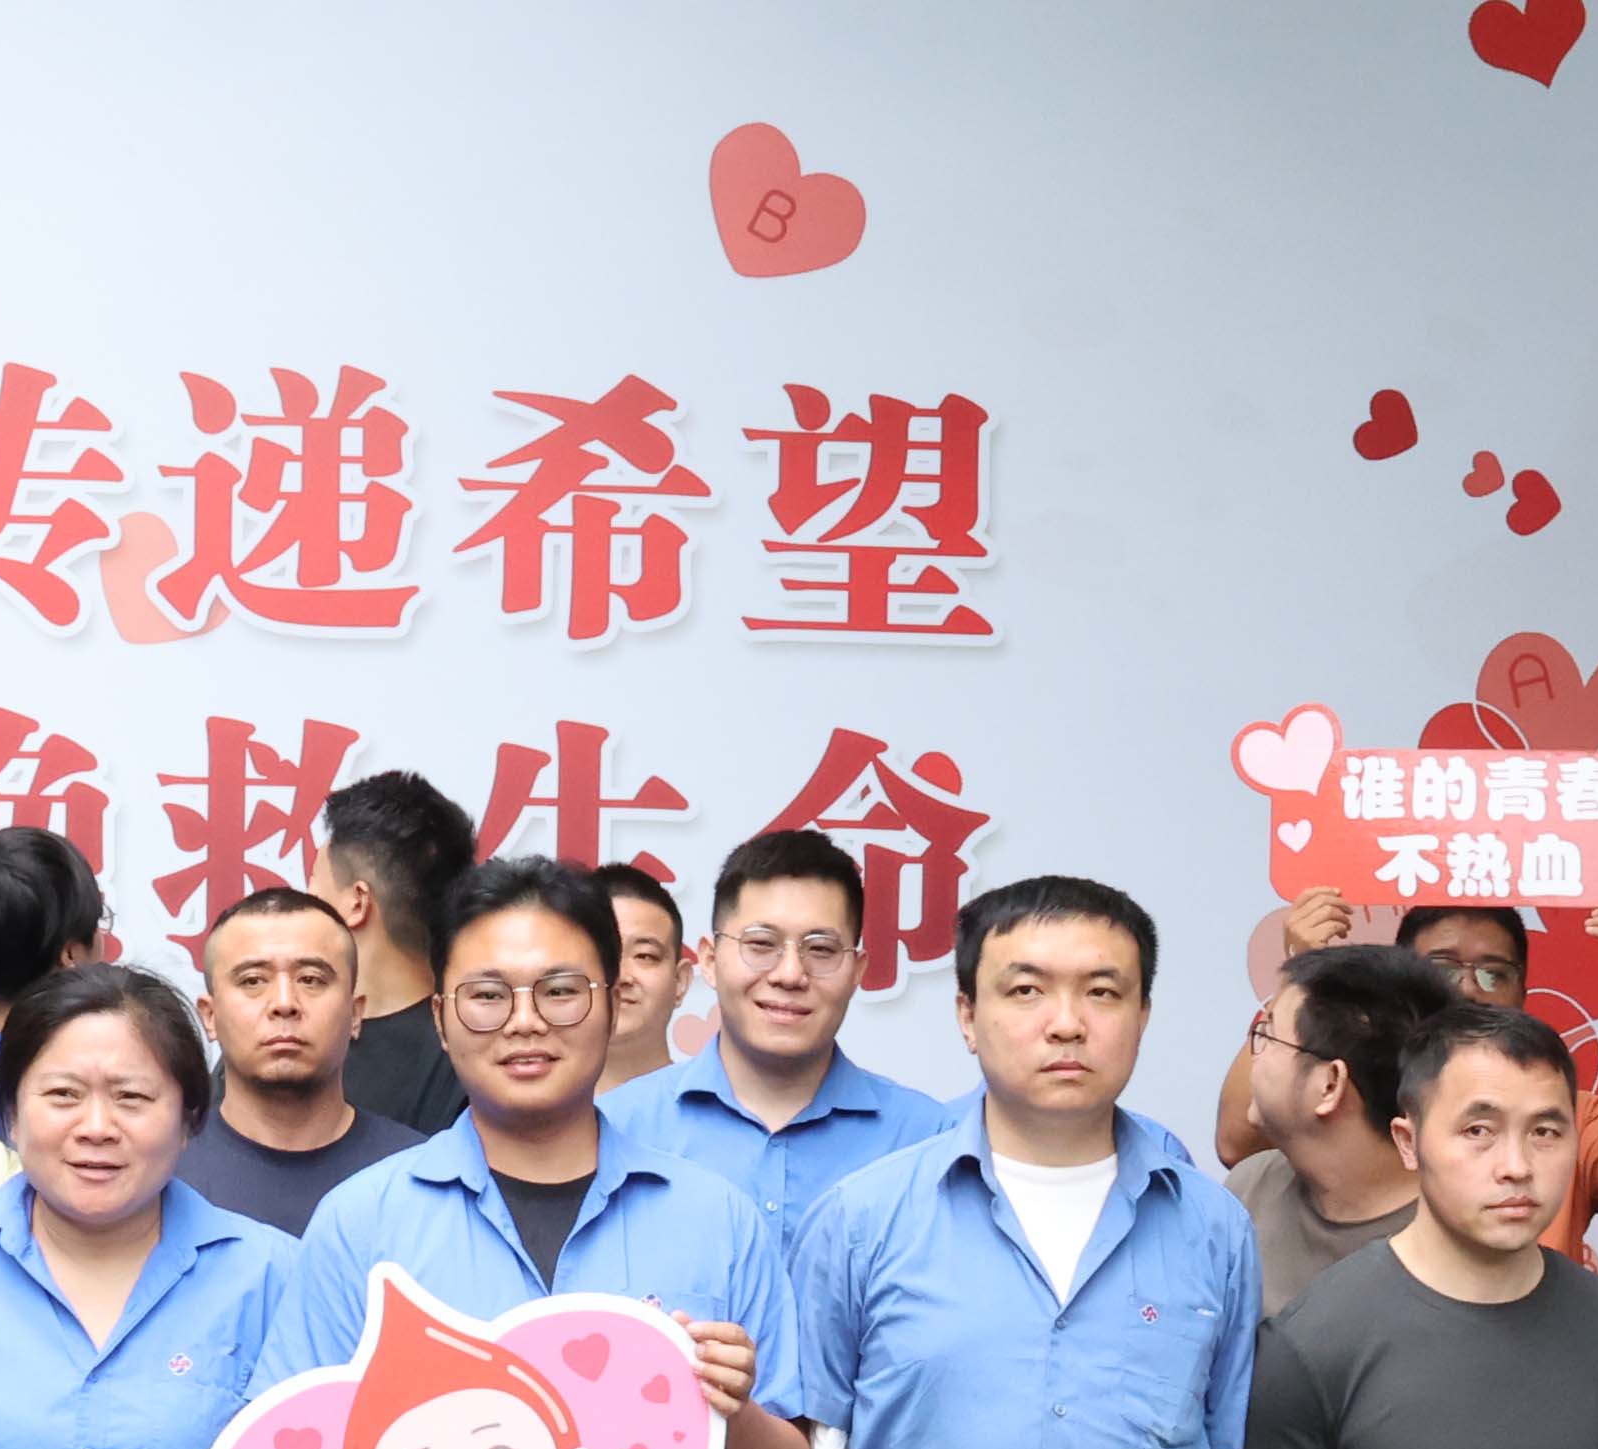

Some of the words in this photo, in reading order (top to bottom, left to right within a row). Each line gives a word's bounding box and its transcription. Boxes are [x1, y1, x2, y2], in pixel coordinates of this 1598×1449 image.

[747, 189, 796, 243] B
[1508, 653, 1554, 709] A
[1375, 833, 1584, 899] 不热血
